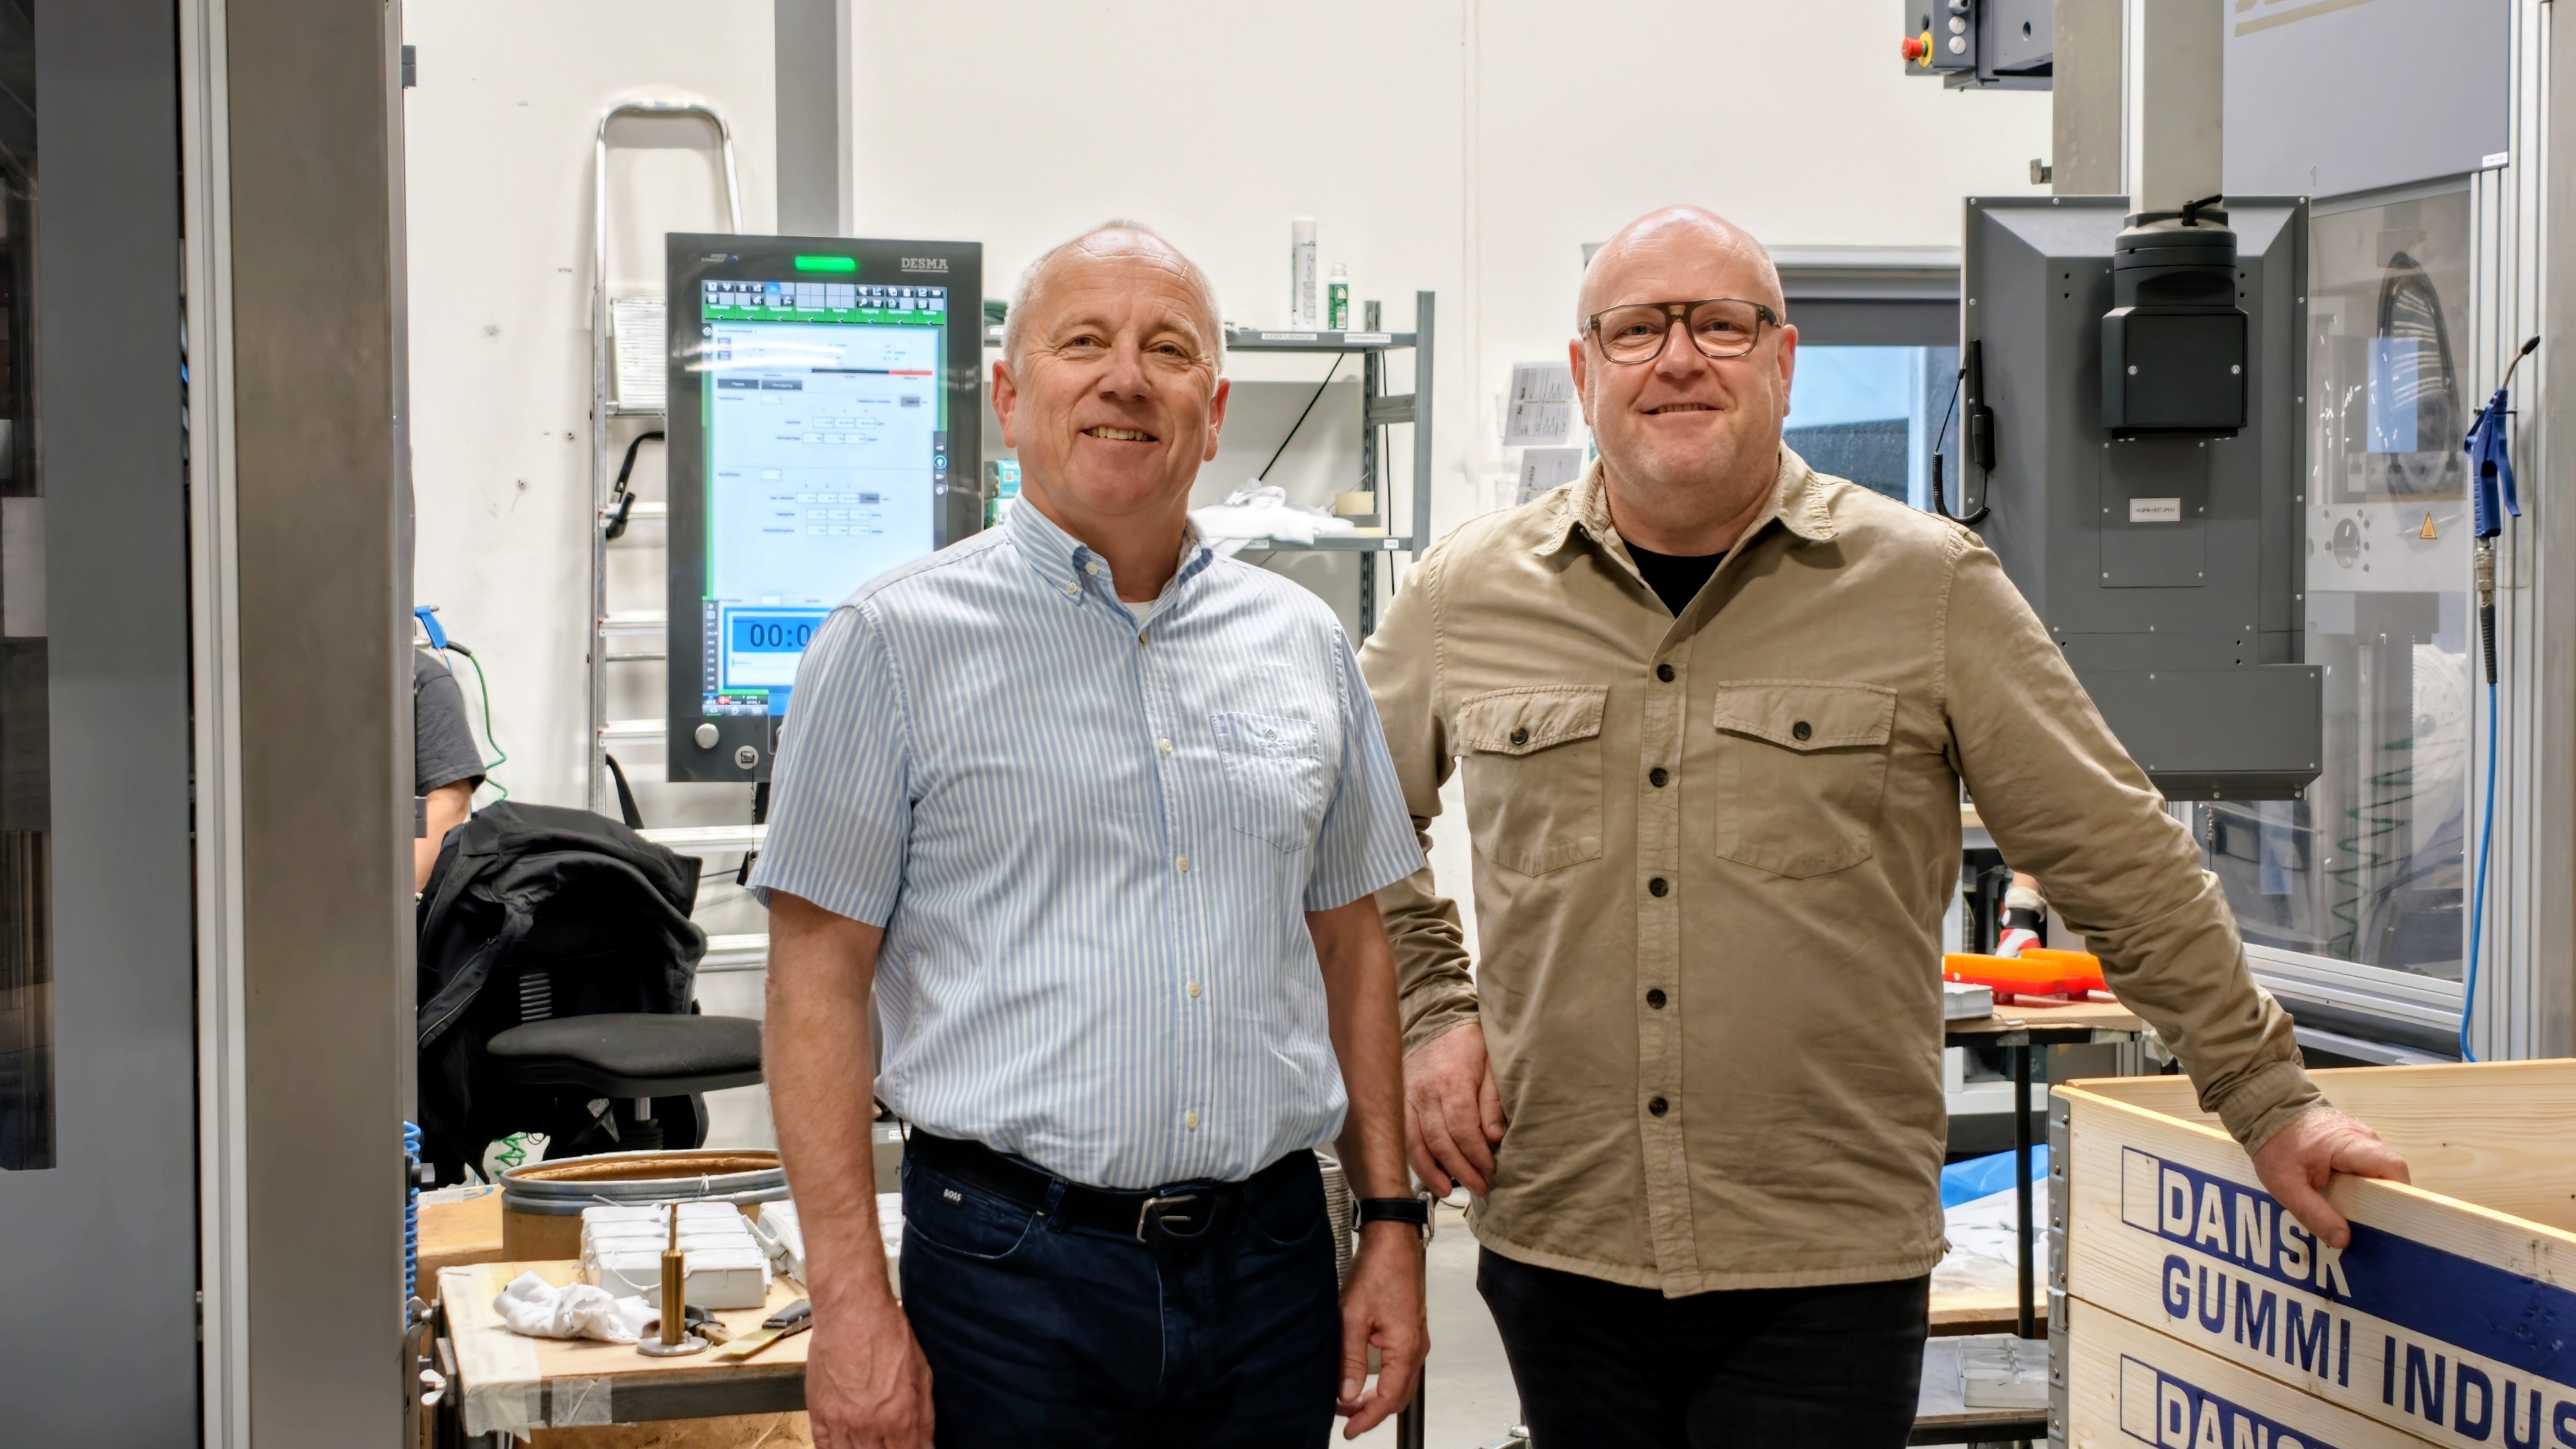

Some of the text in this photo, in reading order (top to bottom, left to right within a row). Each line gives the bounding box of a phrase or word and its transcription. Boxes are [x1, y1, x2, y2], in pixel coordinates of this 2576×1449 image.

[901, 258, 949, 270] DESMA
[750, 624, 813, 647] 00:0
[944, 1188, 962, 1202] BOSS
[2163, 1168, 2352, 1298] DANSK
[2162, 1254, 2350, 1388] GUMMI
